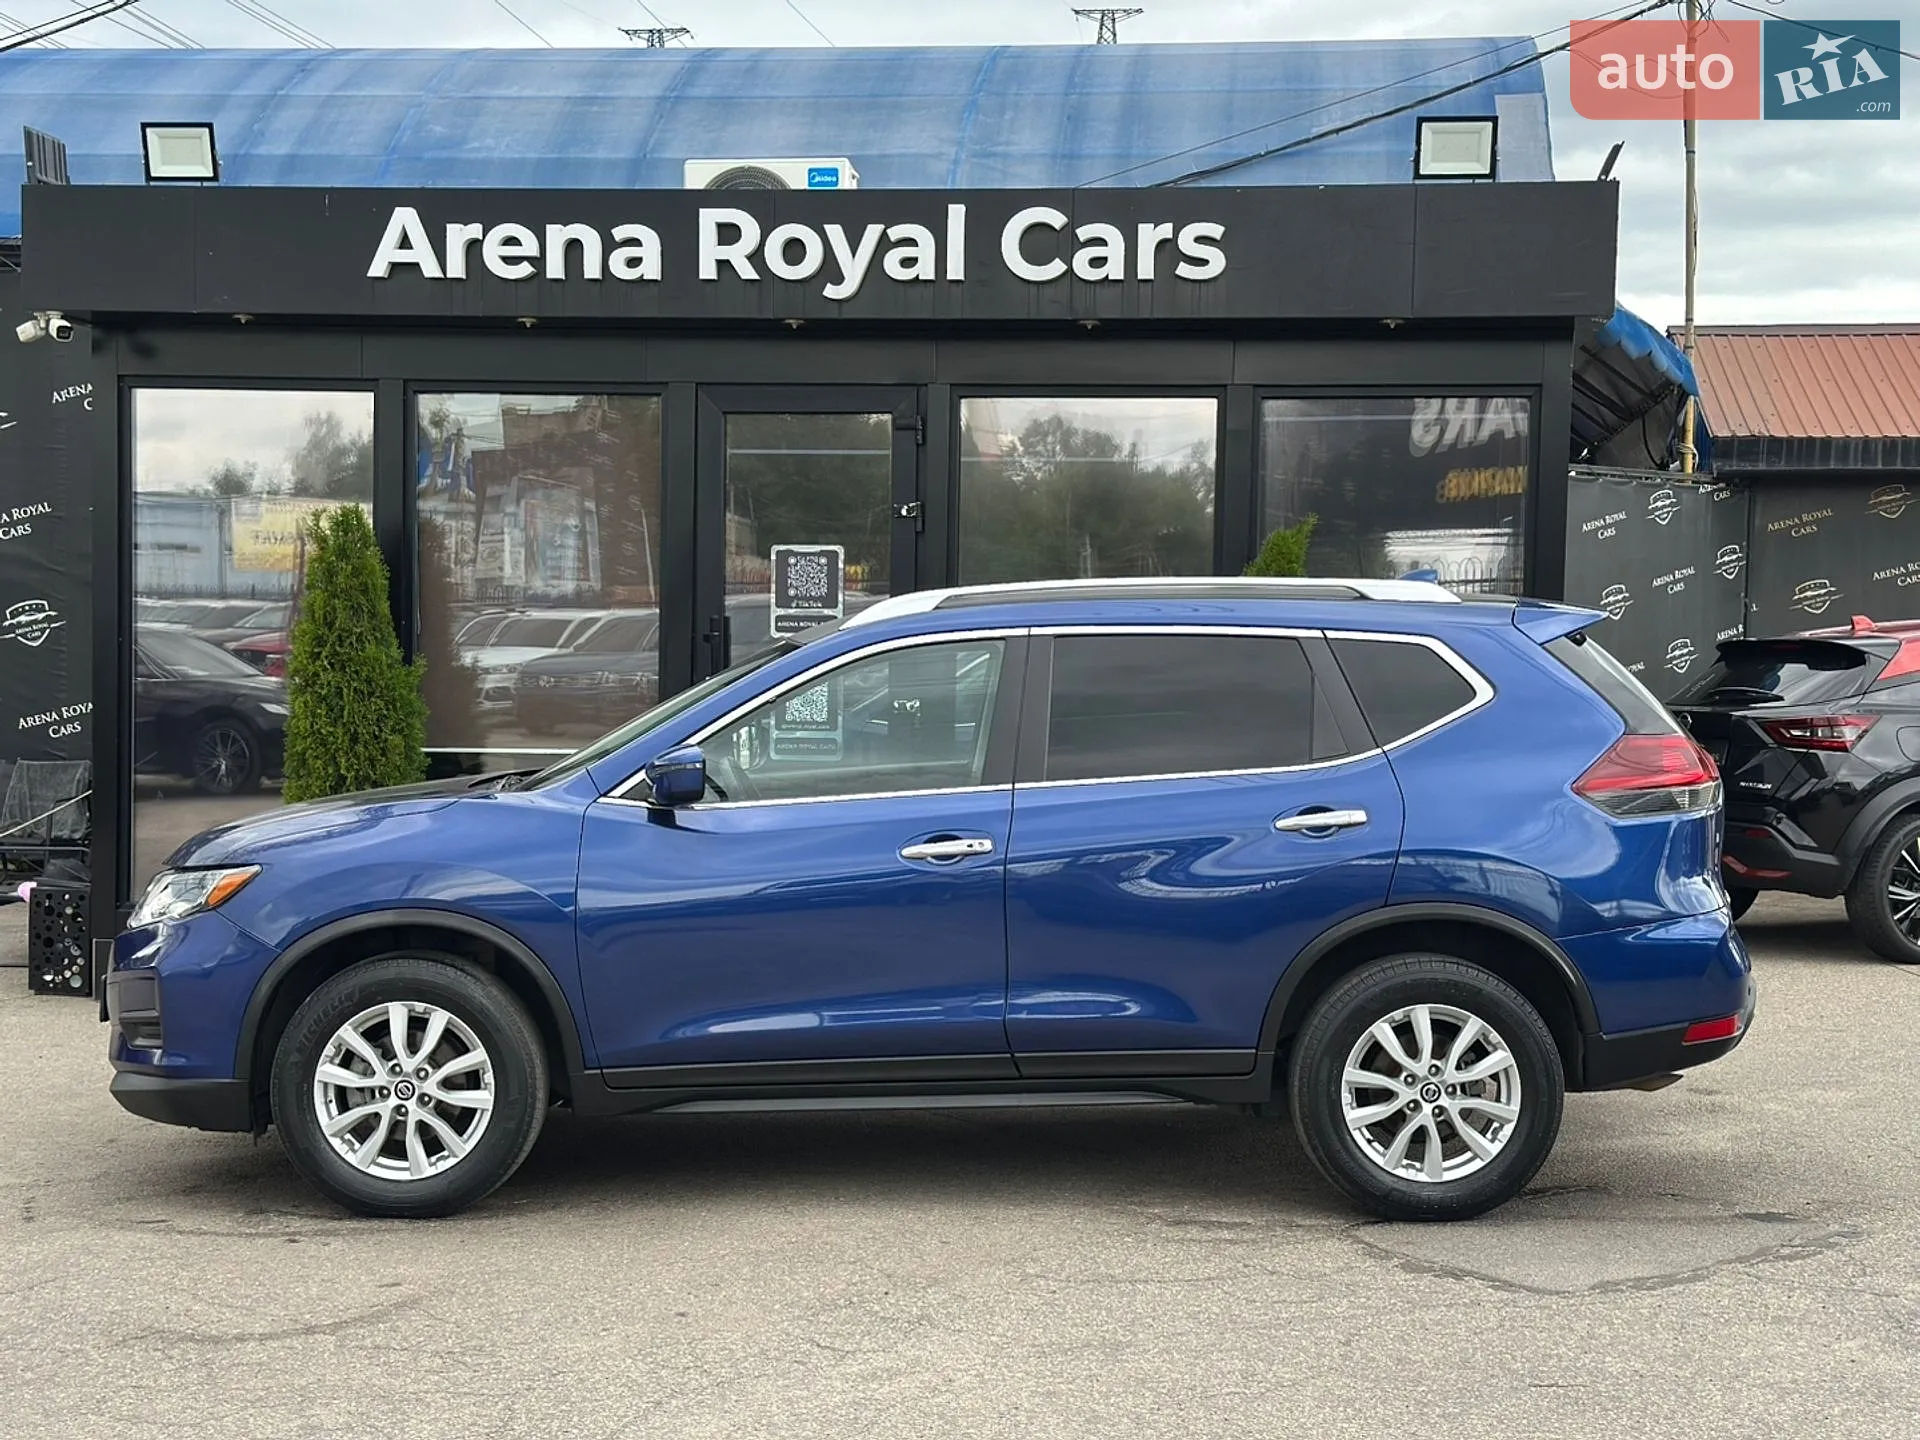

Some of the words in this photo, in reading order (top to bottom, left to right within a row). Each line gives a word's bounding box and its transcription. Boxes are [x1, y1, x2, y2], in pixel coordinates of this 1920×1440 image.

[367, 207, 662, 281] Arena
[699, 203, 966, 299] Royal
[1000, 206, 1227, 282] Cars
[18, 711, 60, 729] ARENA
[49, 721, 82, 738] CARS
